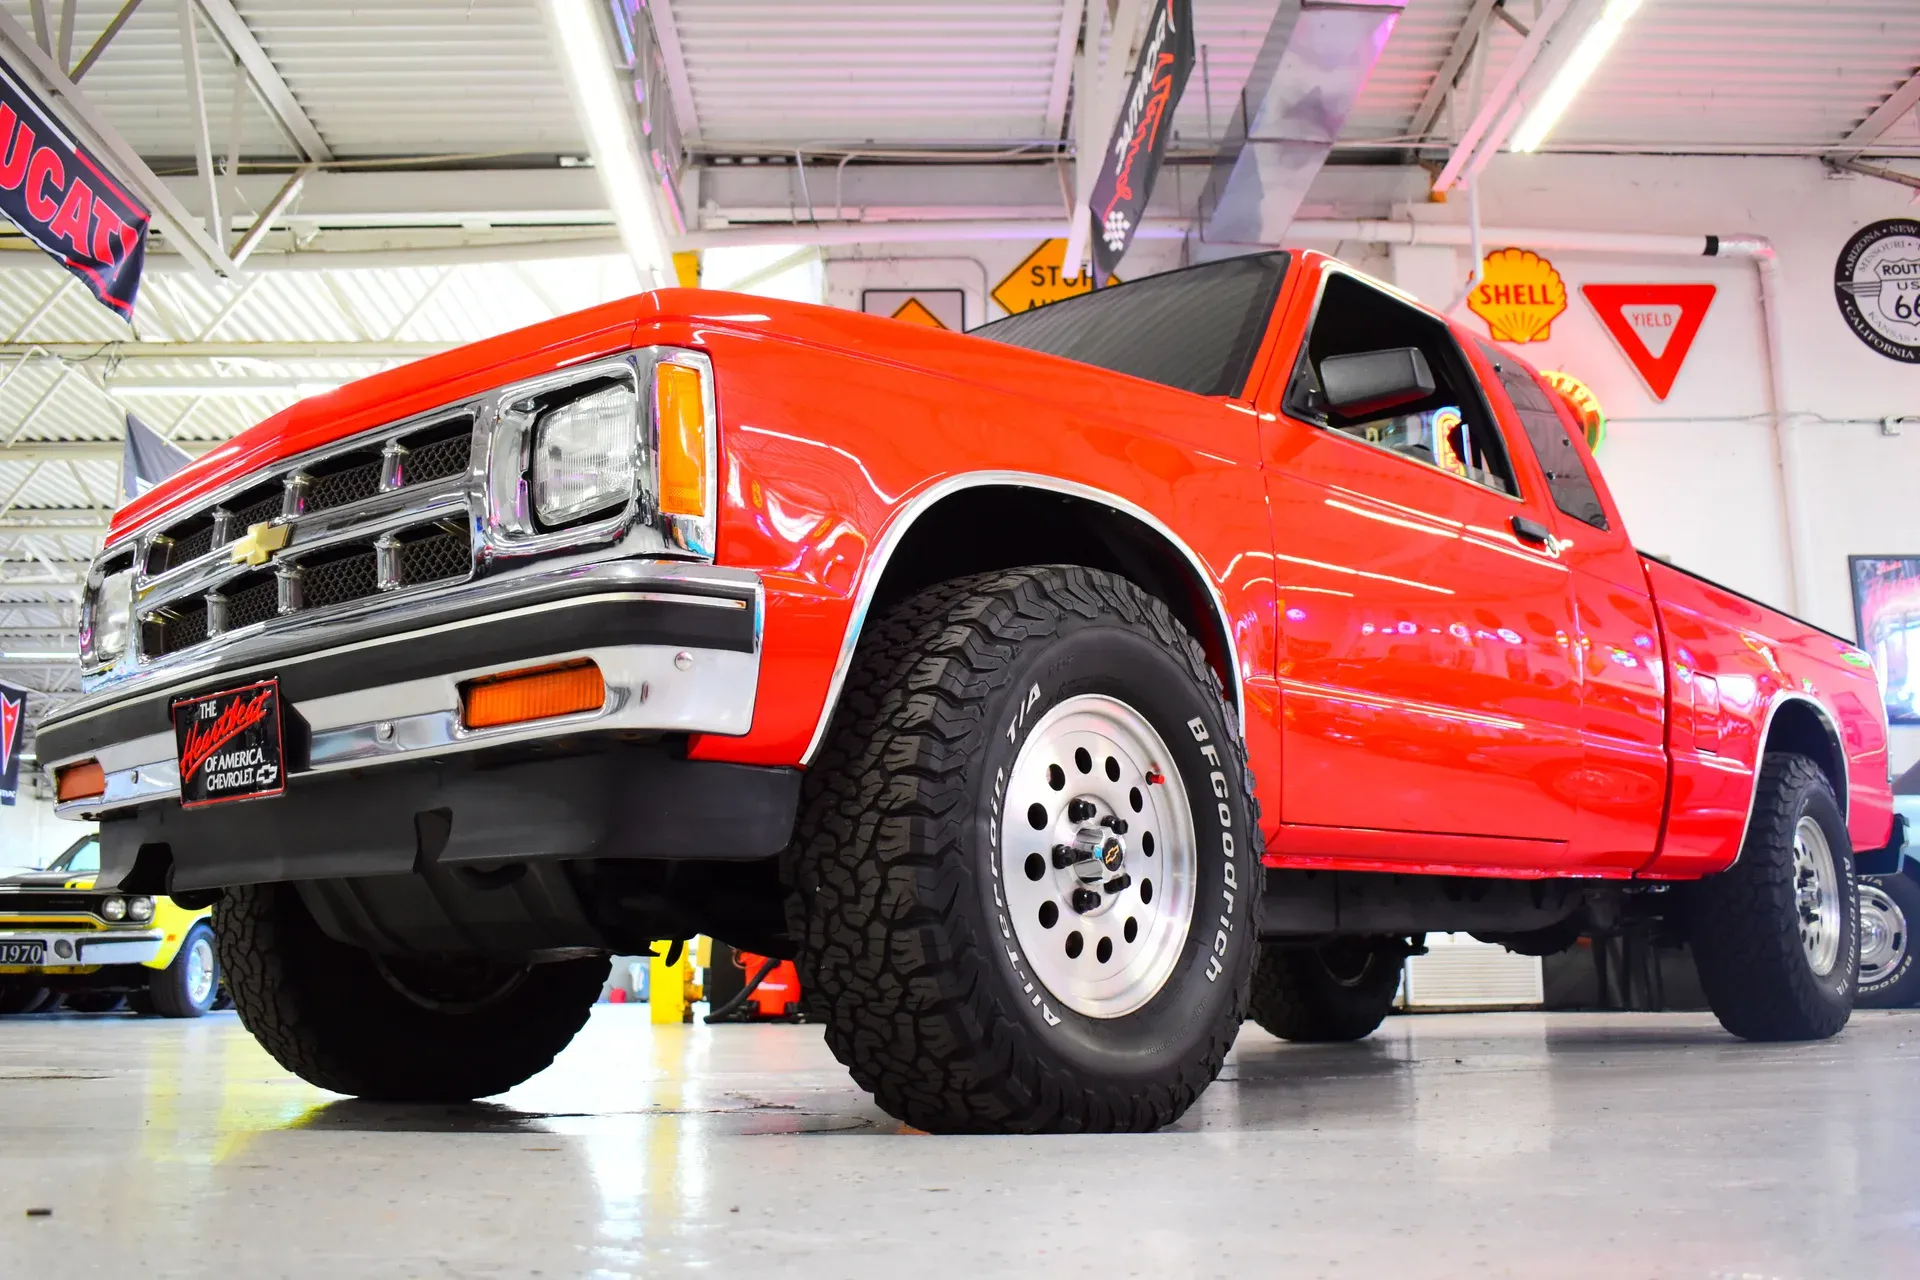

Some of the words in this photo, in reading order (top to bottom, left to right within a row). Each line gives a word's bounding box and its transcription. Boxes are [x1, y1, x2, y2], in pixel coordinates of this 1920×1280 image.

[1845, 229, 1882, 273] ARIZONA
[1889, 224, 1918, 235] NEW
[1882, 262, 1920, 276] ROUT
[1479, 283, 1556, 306] SHELL
[1631, 312, 1673, 328] YIELD
[1846, 305, 1915, 359] CALIFORNIA
[200, 700, 217, 720] THE
[1006, 681, 1042, 744] T/A
[204, 756, 219, 773] OF
[1187, 716, 1238, 982] BFGoodrich
[1, 945, 42, 962] 1970
